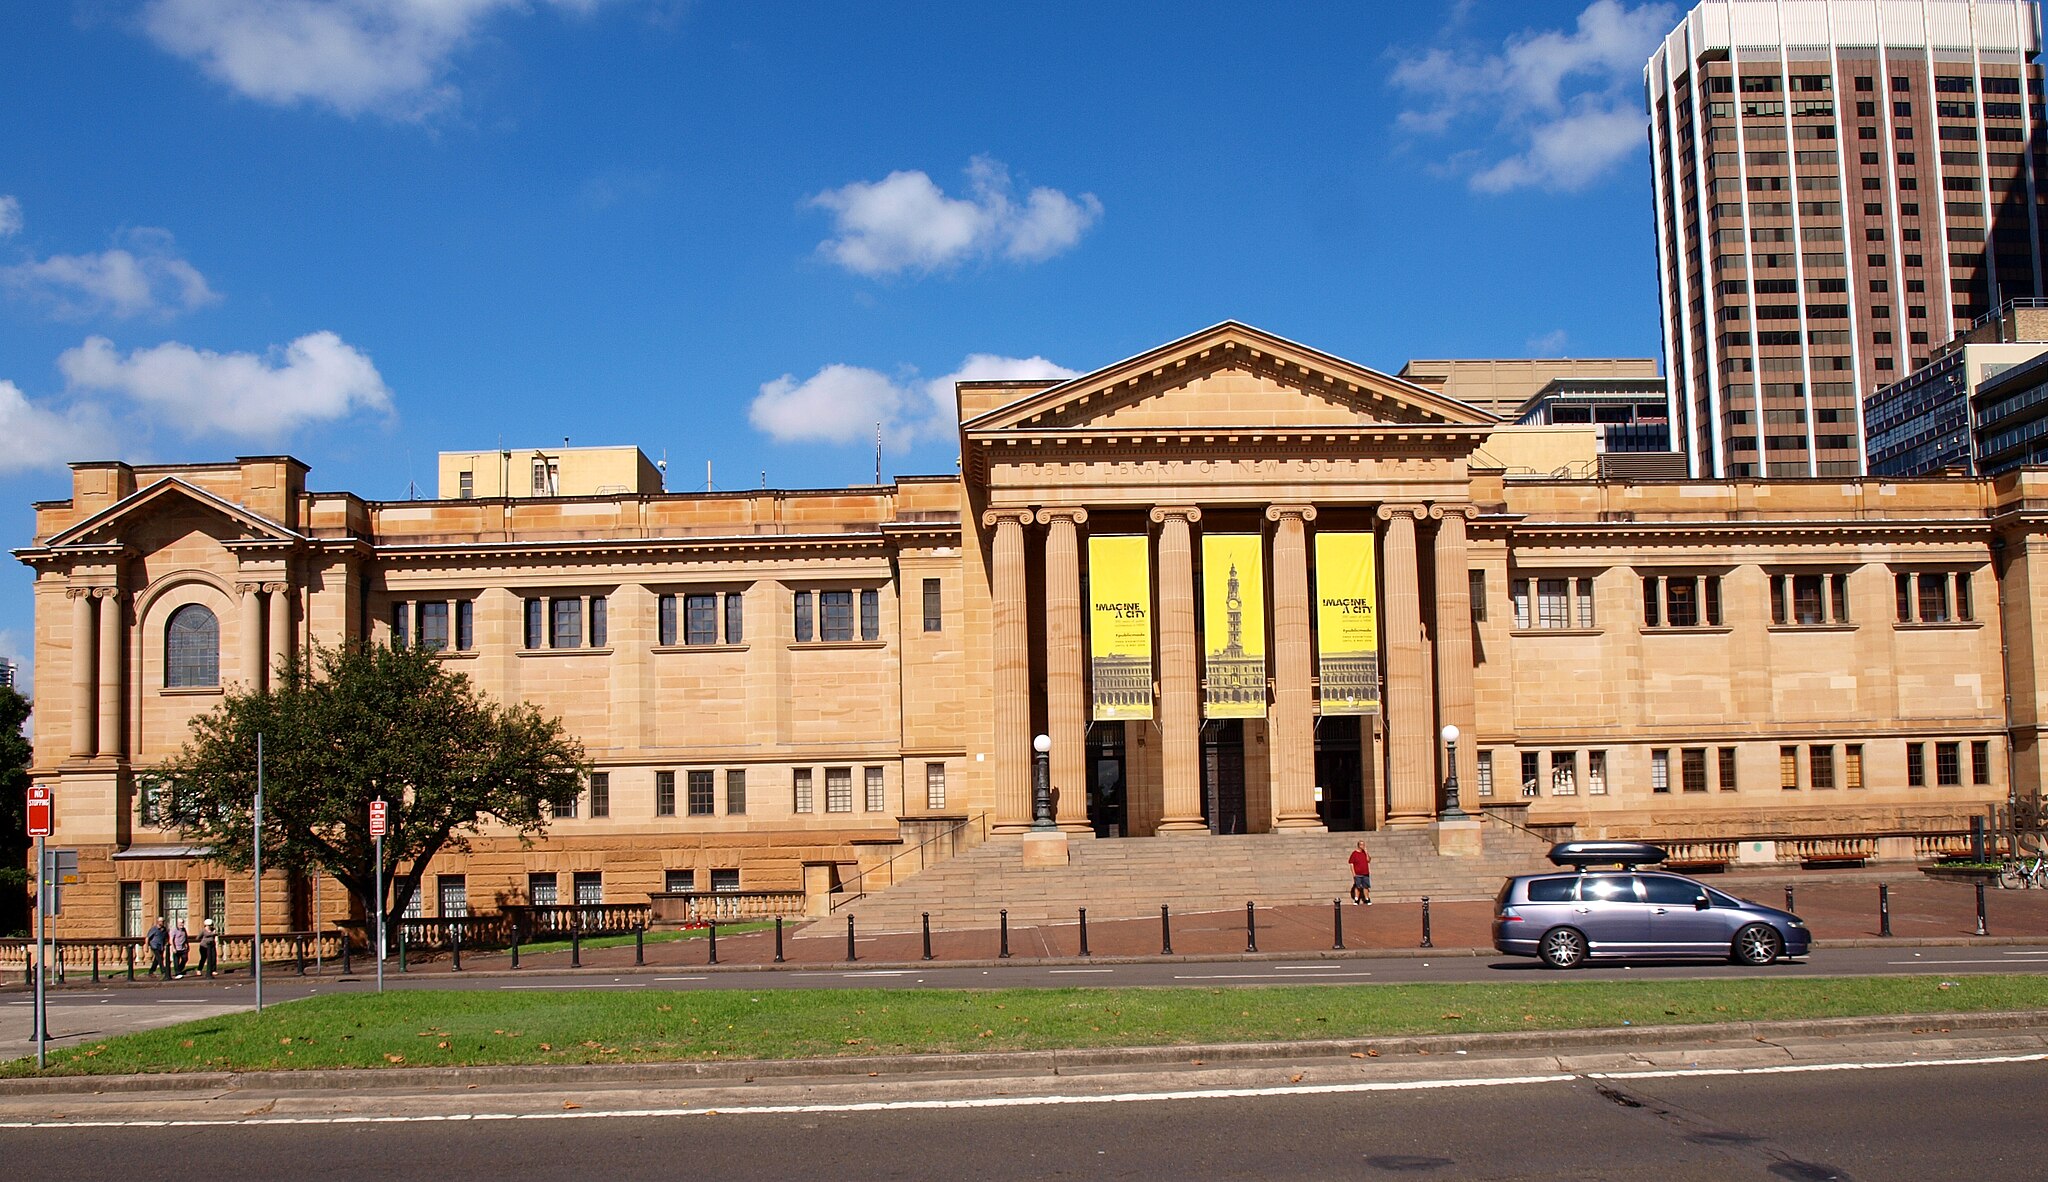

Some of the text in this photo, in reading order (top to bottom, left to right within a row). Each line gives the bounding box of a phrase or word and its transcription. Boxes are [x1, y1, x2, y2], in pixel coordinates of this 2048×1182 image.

[1020, 459, 1437, 477] PUBLIC LIBRARY OF NEW SOUTH WALES
[1342, 606, 1373, 614] A CITY
[1115, 610, 1146, 619] A CITY
[34, 790, 44, 798] NO
